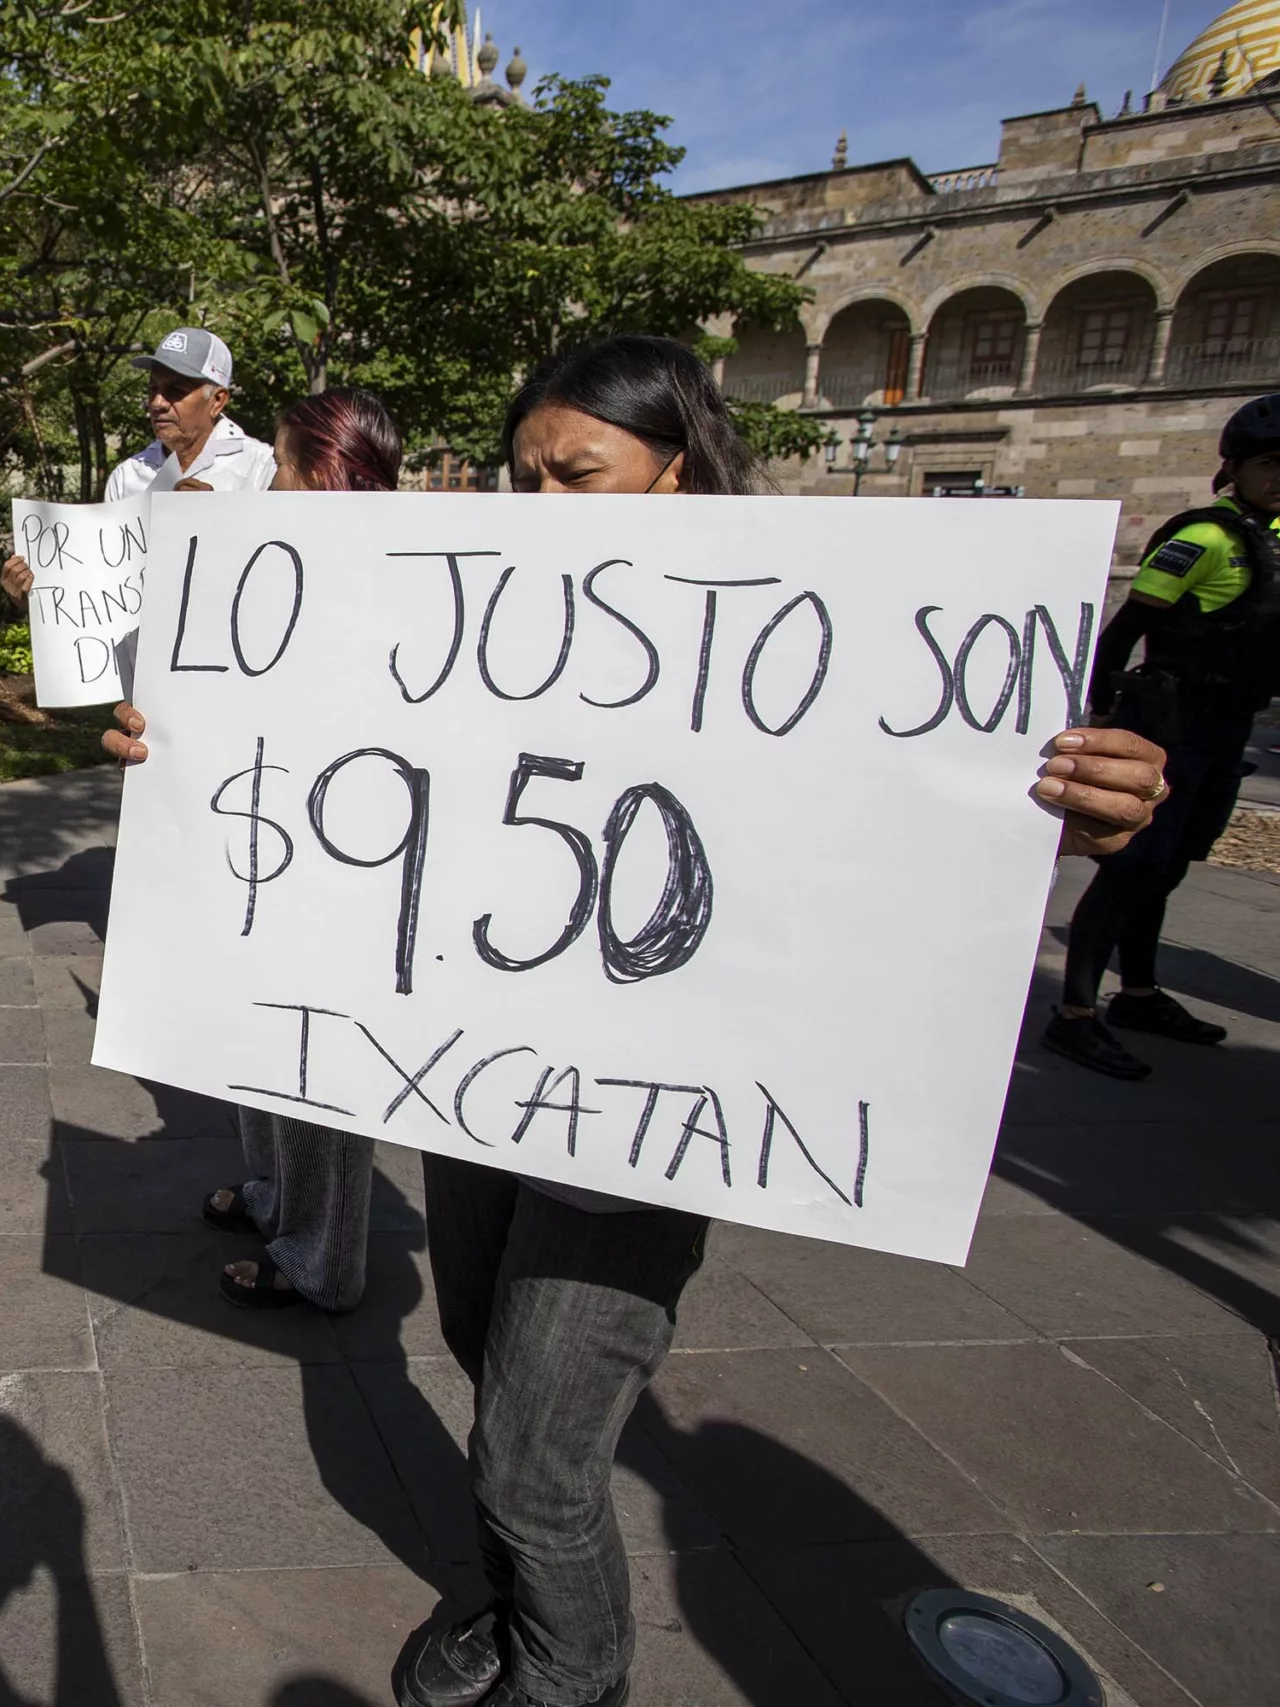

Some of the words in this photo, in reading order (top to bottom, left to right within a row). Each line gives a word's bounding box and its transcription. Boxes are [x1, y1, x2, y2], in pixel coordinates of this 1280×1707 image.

[22, 514, 83, 570] POR
[99, 516, 147, 567] UN
[171, 535, 304, 677] LO
[385, 550, 833, 738] JUSTO
[877, 602, 1094, 738] SON
[210, 735, 715, 996] $9.50
[227, 1001, 869, 1210] IXCATAN
